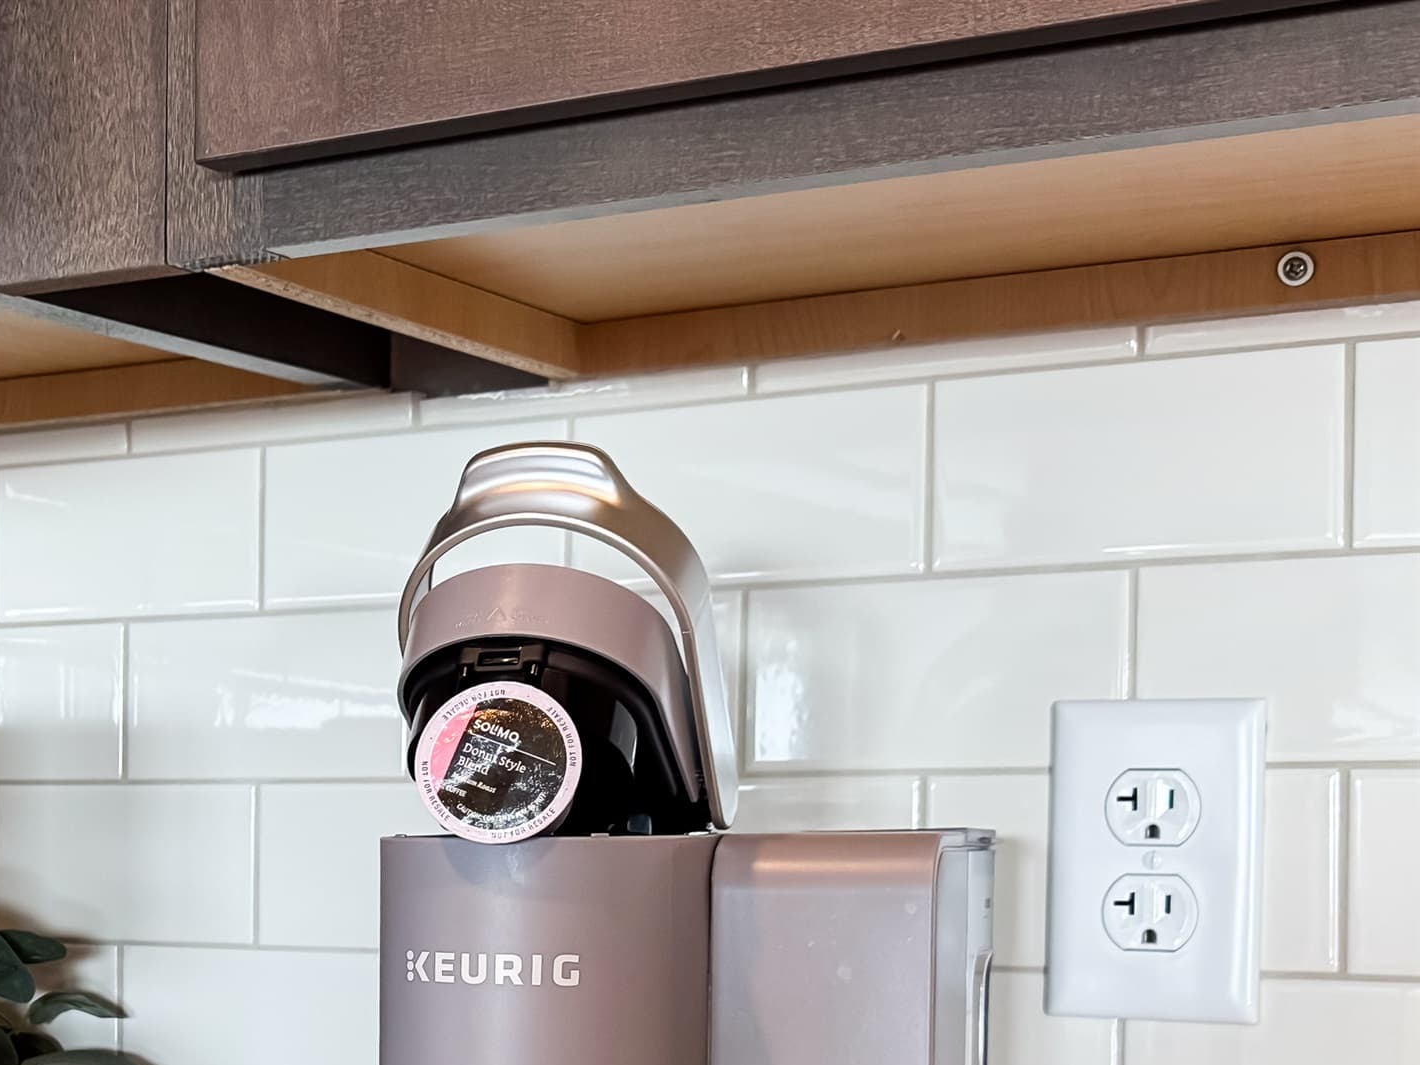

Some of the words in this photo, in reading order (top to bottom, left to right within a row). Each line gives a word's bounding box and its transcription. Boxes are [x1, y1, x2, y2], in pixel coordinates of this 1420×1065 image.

[473, 719, 520, 743] SOLIMO
[457, 755, 490, 776] Blend
[462, 742, 498, 763] Donut
[498, 755, 527, 774] Style
[406, 949, 580, 987] KEURIG
